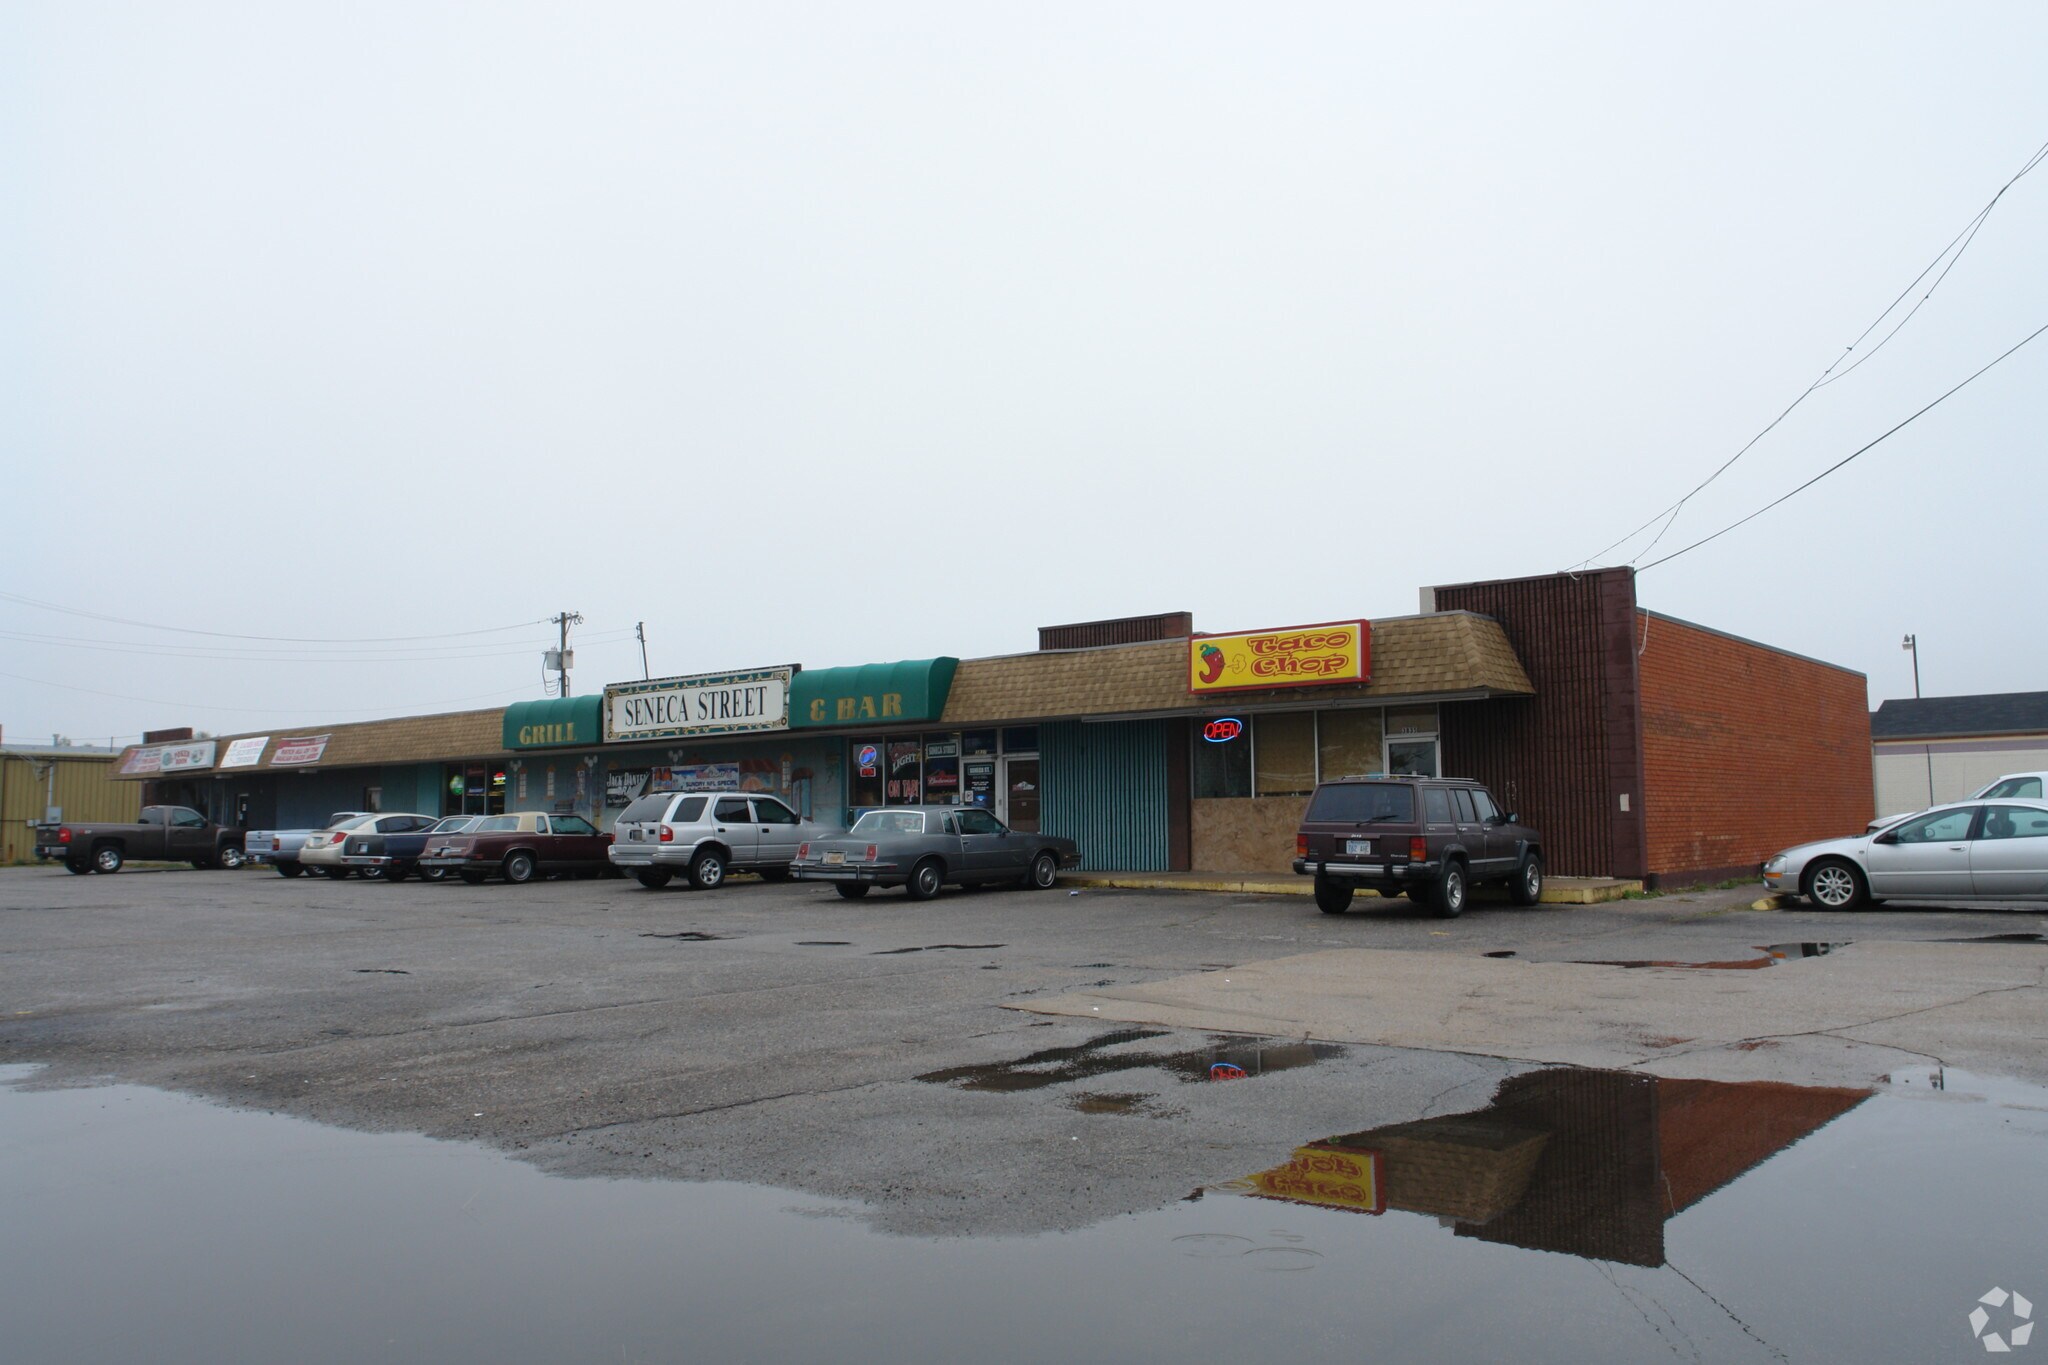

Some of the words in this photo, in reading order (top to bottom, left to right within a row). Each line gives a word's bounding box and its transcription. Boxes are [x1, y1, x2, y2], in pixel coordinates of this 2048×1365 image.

[1247, 631, 1351, 656] Taco
[1251, 653, 1348, 677] Chop
[624, 689, 689, 727] SENECA
[697, 685, 768, 721] STREET
[837, 692, 903, 720] BAR
[519, 722, 578, 745] GRILL
[1203, 721, 1241, 739] OPEN
[892, 753, 917, 775] LIGHT
[888, 779, 900, 797] ON
